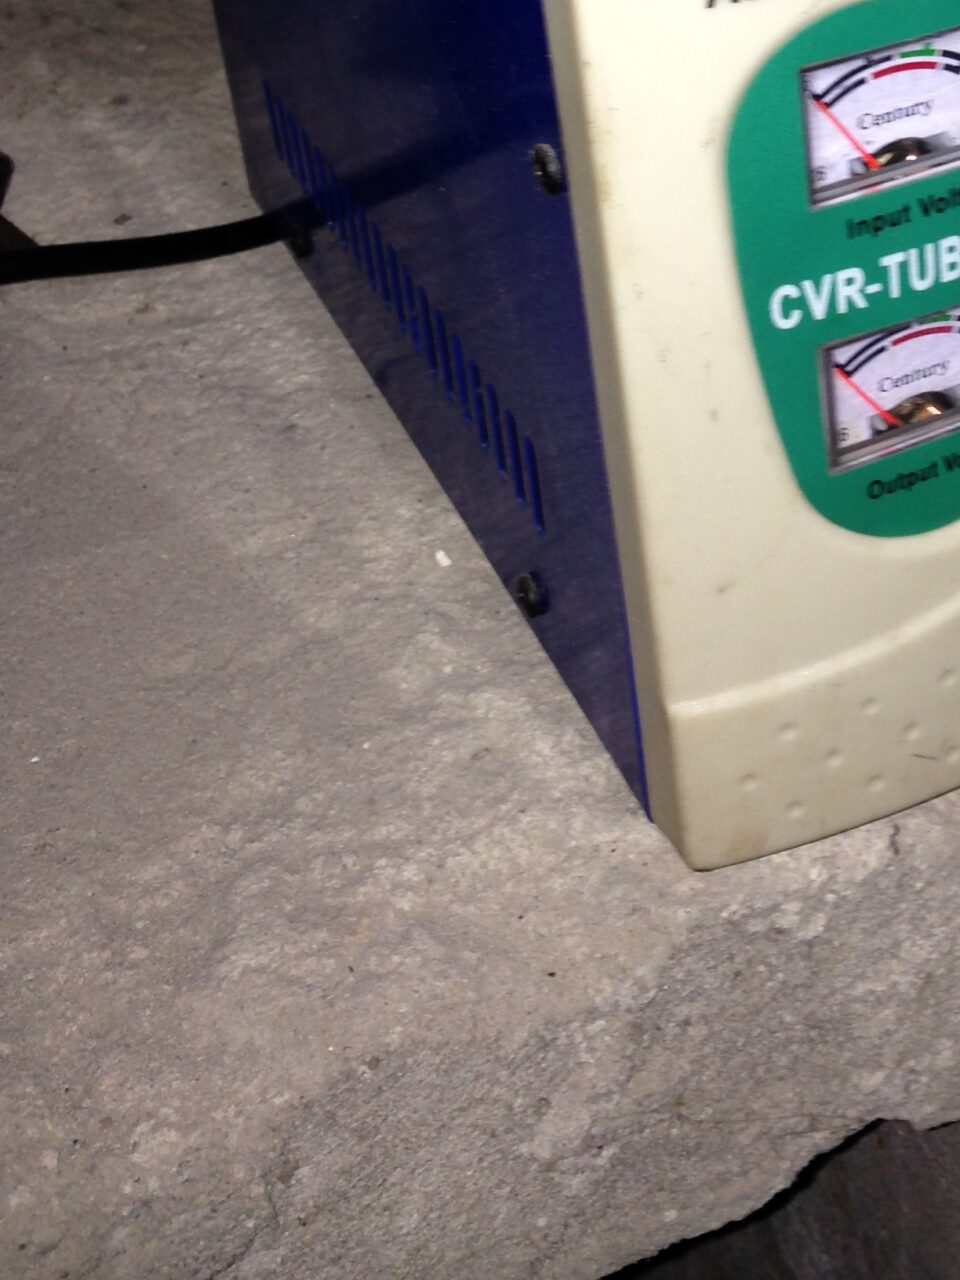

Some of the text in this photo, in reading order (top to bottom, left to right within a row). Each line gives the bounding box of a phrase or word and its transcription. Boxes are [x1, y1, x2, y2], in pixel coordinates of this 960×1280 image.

[857, 99, 935, 130] Century
[846, 206, 911, 239] Input
[877, 360, 952, 393] Century
[867, 460, 939, 500] Output
